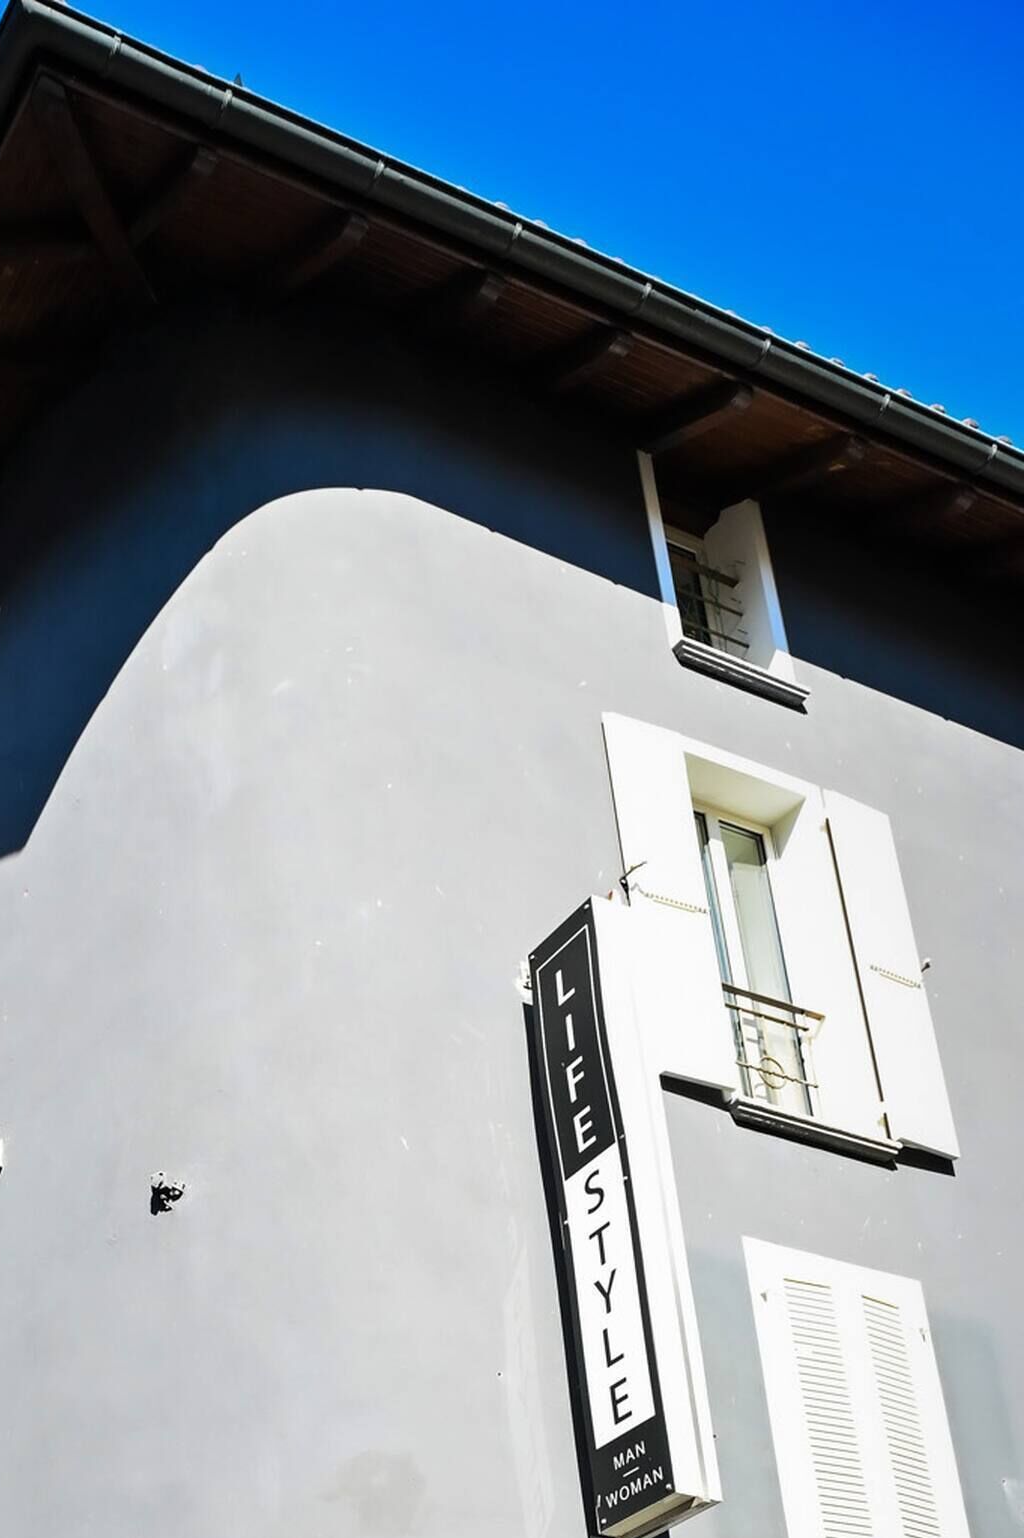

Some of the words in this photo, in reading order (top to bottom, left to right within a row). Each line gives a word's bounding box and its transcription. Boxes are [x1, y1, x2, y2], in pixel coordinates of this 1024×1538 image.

[555, 968, 597, 1153] LIFE
[584, 1169, 633, 1425] STYLE
[604, 1465, 665, 1509] WOMAN
[612, 1440, 647, 1470] MAN
